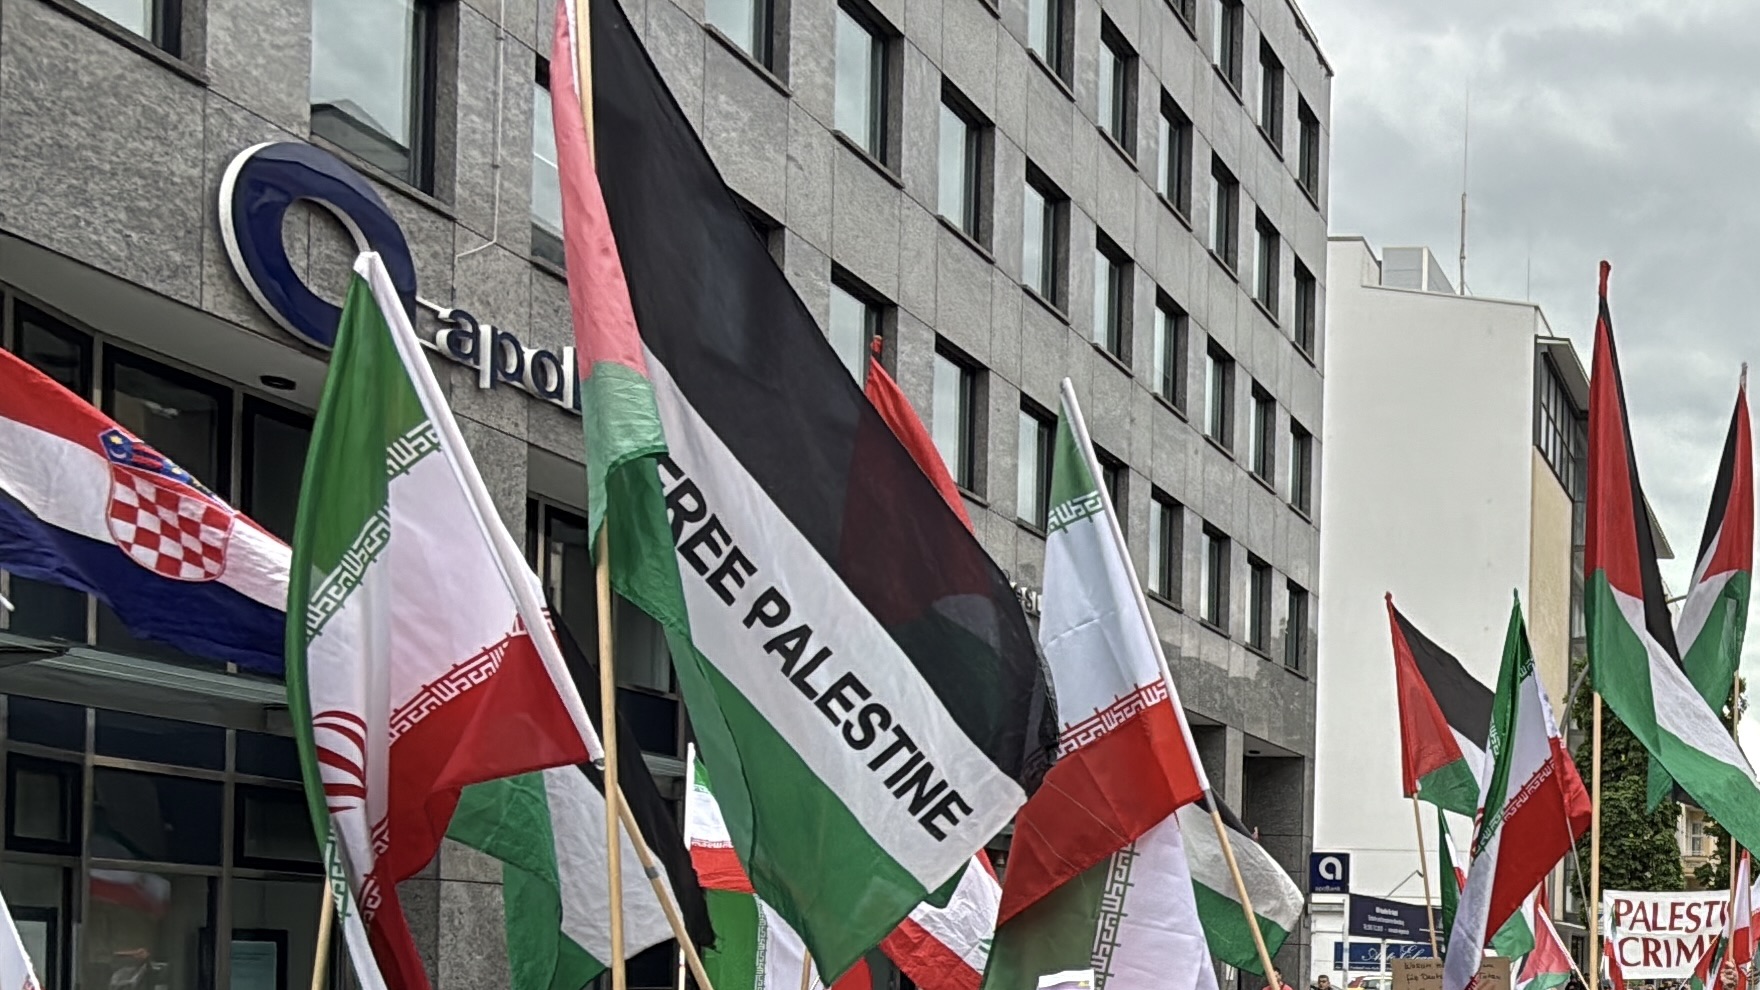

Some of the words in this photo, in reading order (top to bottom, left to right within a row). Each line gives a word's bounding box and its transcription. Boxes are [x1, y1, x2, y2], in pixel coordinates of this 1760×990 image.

[435, 308, 582, 415] apo
[743, 586, 974, 842] PALESTINE
[1619, 936, 1719, 968] CRIM
